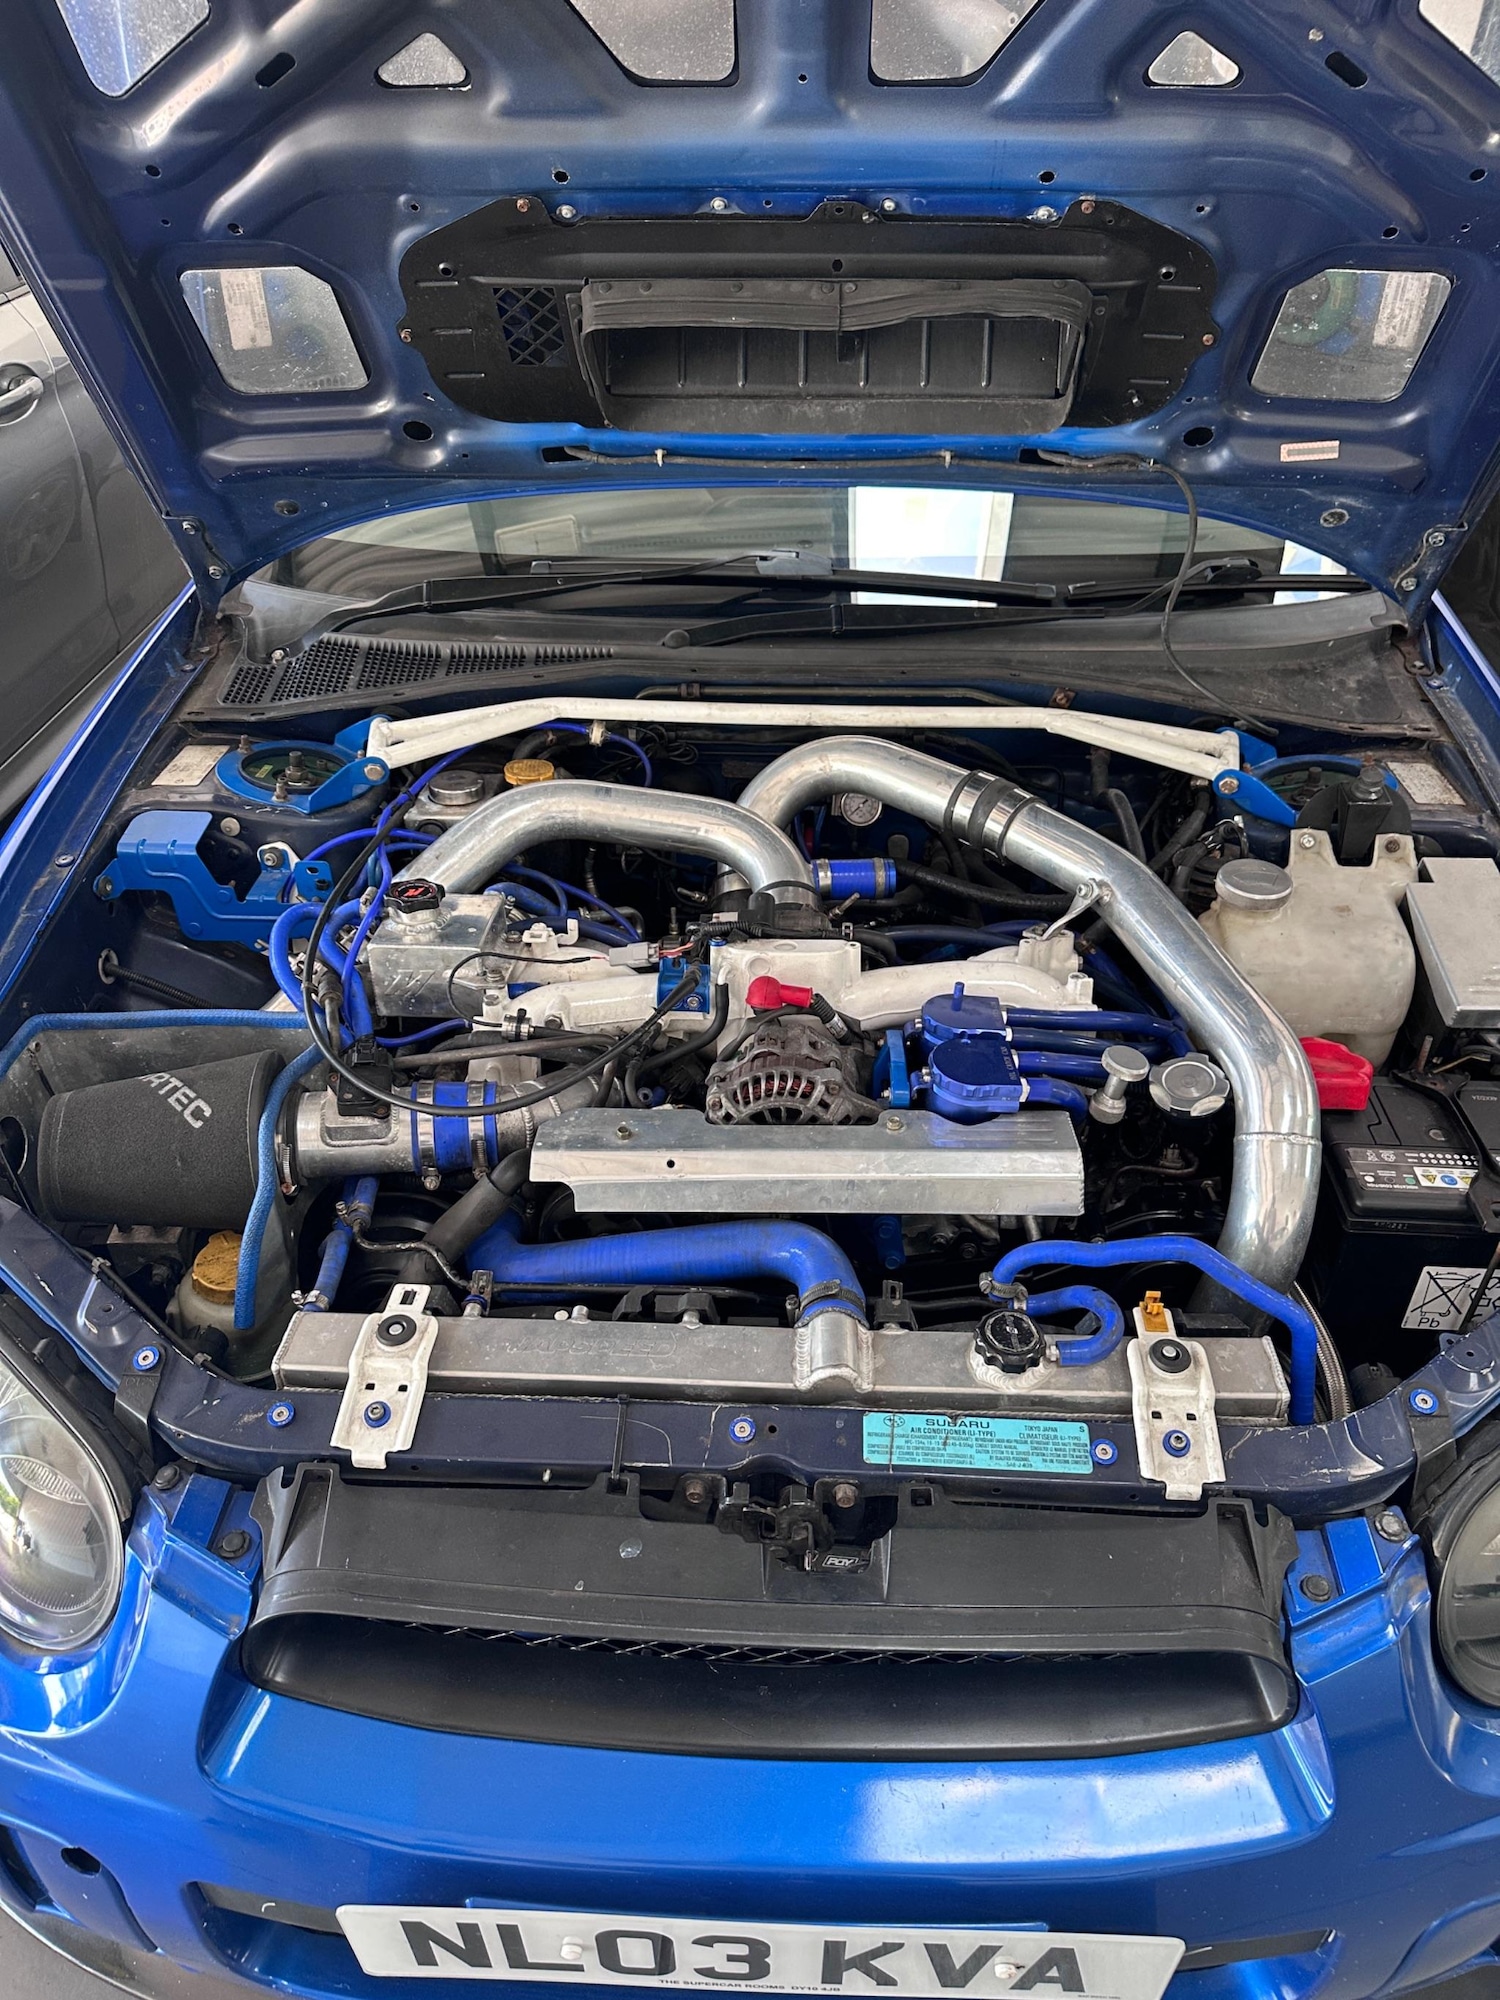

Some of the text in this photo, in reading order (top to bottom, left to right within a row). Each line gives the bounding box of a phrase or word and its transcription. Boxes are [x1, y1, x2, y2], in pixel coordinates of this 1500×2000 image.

[1417, 1317, 1440, 1329] Pb
[925, 1418, 990, 1429] SUBARU
[923, 1427, 966, 1436] CONDITIONER
[1024, 1425, 1058, 1433] TOKYO JAPAN
[399, 1920, 1086, 1993] NL03 KVA
[683, 1980, 742, 1988] SUPERCAR
